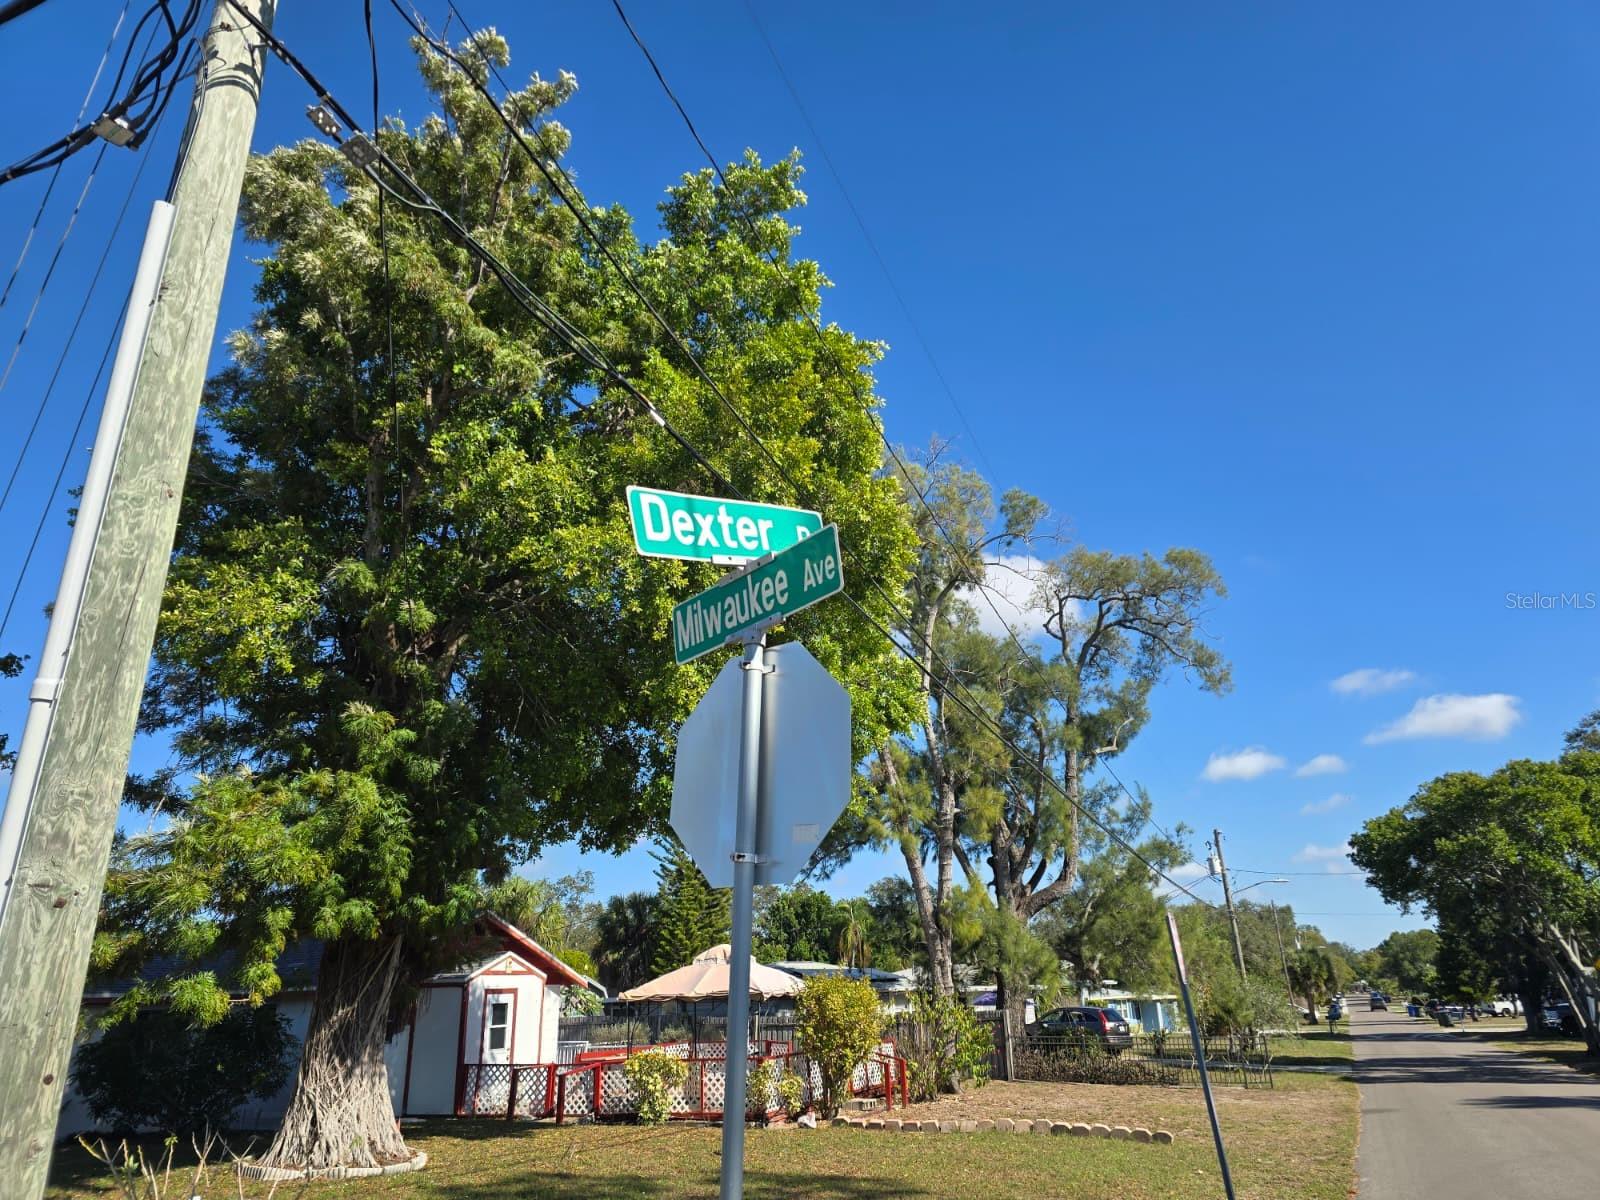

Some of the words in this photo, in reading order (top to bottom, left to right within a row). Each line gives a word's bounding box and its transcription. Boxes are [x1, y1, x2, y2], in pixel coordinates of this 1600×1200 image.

[639, 493, 773, 550] Dexter
[676, 569, 789, 651] Milwaukee
[803, 554, 835, 592] Ave
